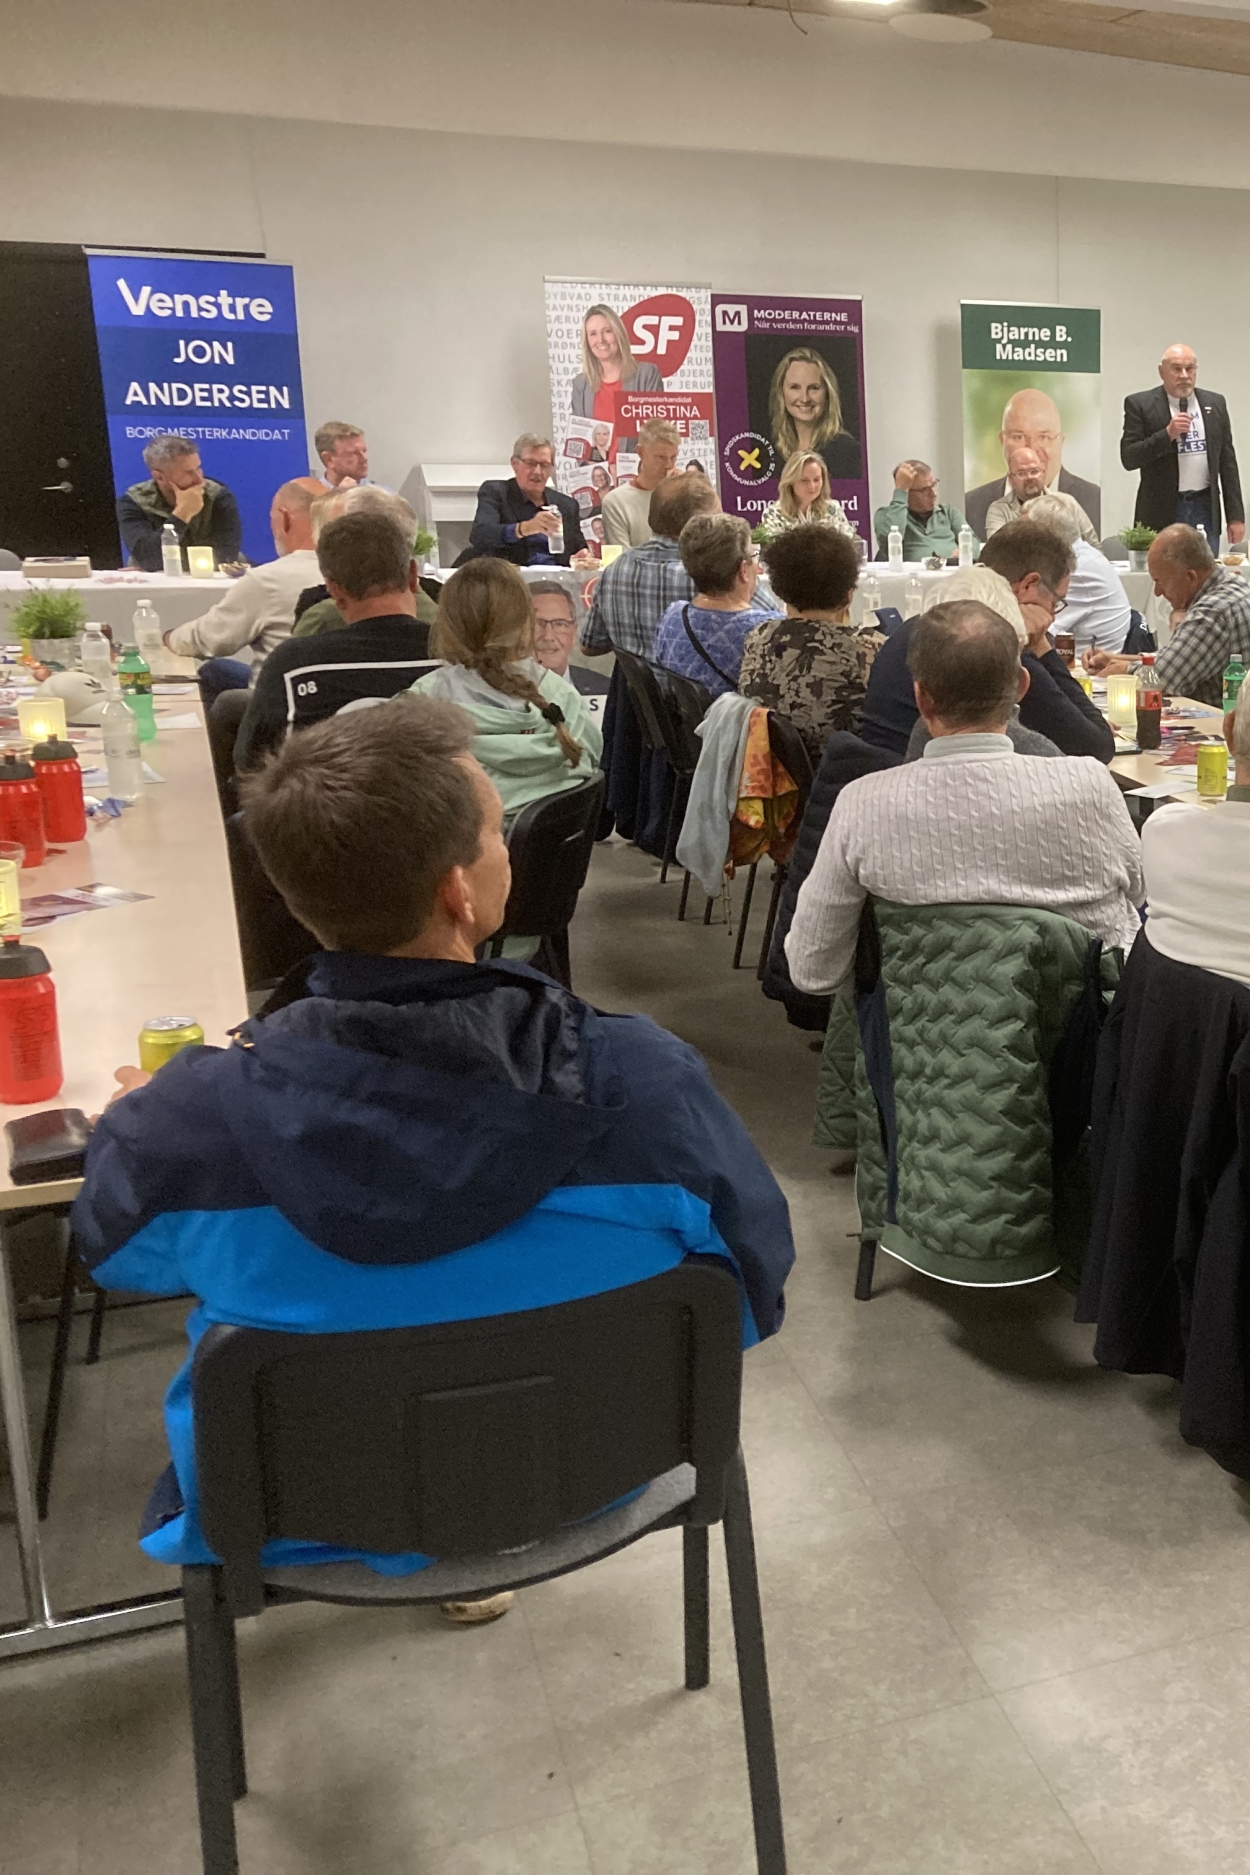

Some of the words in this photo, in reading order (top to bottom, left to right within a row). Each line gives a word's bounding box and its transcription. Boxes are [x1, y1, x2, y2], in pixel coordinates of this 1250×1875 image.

[116, 278, 273, 322] Venstre
[722, 310, 742, 326] M
[754, 309, 849, 322] MODERATERNE
[630, 315, 684, 355] SF
[772, 322, 803, 330] verden
[804, 322, 845, 331] forandrer
[847, 323, 859, 333] sig
[990, 322, 1051, 344] Bjarne
[1055, 325, 1072, 342] B.
[173, 340, 235, 365] JON
[995, 344, 1068, 362] Madsen
[125, 382, 291, 409] ANDERSEN
[628, 395, 692, 403] Borgmesterkandidat
[621, 405, 701, 418] CHRISTINA
[126, 427, 291, 440] BORGMESTERKANDIDAT
[724, 432, 769, 456] SPIDSKANDIDAT
[767, 445, 775, 456] TIL
[725, 462, 772, 486] KOMMUNALVALG
[737, 496, 775, 511] Lone
[297, 681, 317, 696] 08
